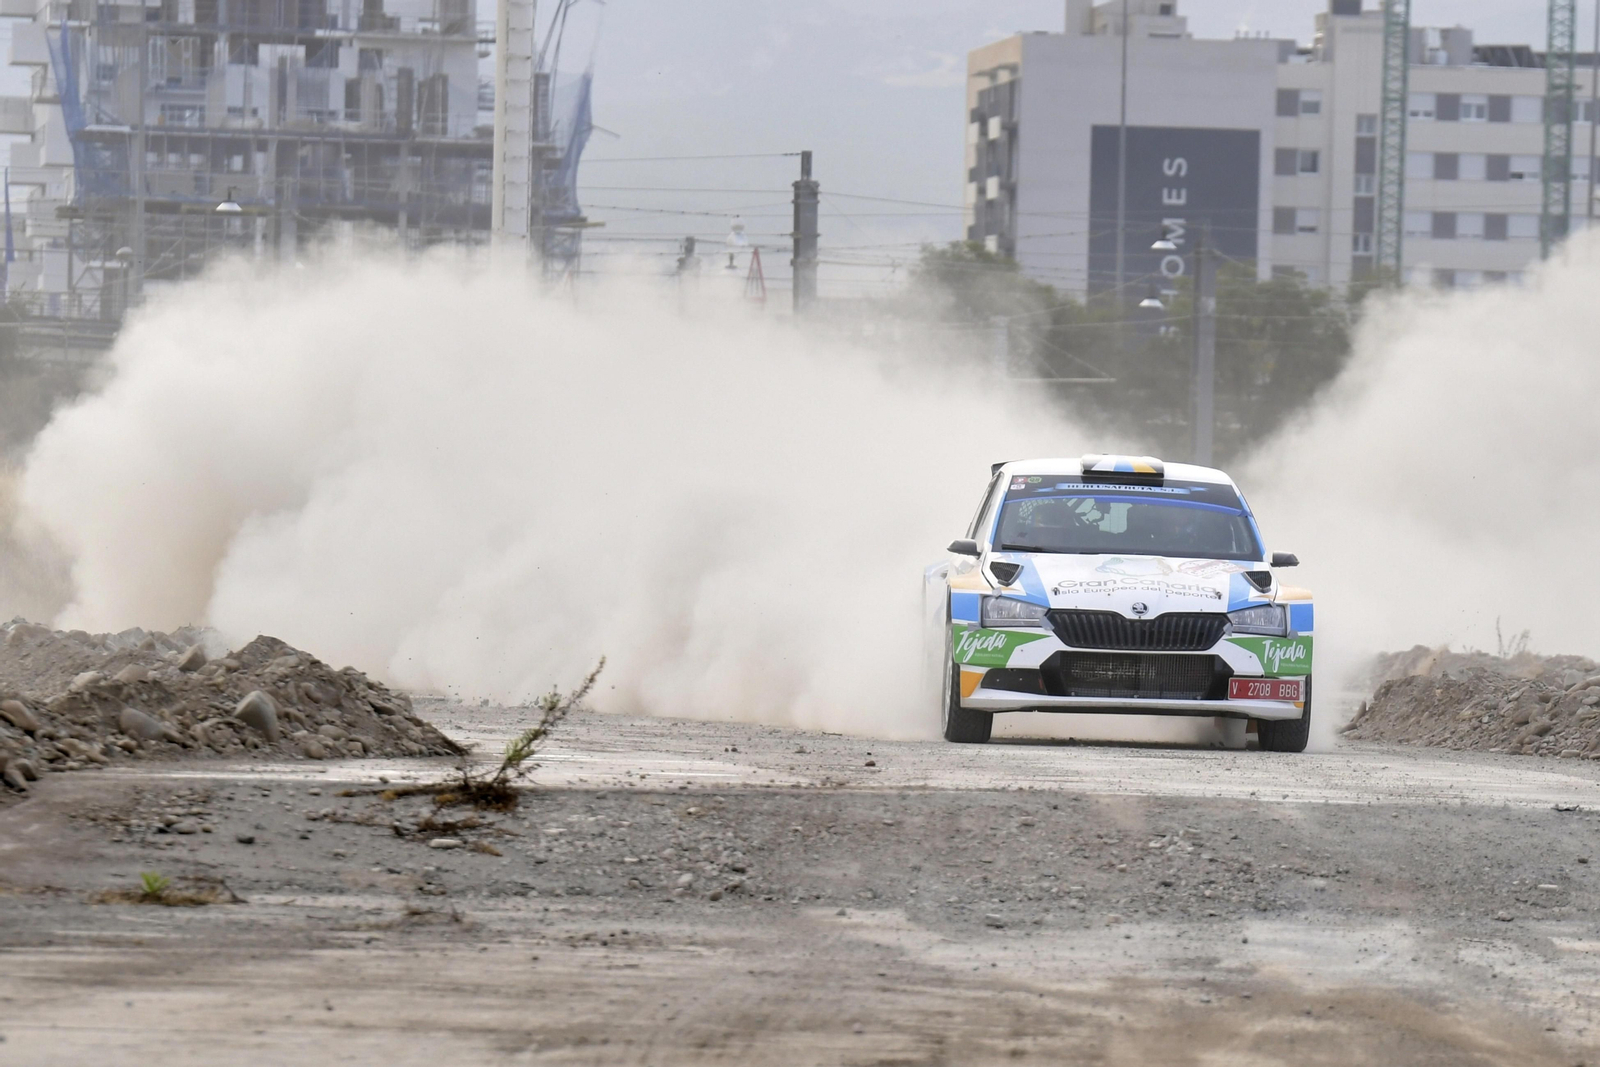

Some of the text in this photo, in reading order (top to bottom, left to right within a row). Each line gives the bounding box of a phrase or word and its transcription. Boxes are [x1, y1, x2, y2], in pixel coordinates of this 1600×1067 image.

[1057, 577, 1218, 593] Gran Canaria
[1084, 586, 1137, 594] Europea
[1165, 589, 1218, 600] Deporte
[956, 630, 1007, 663] Tejeda
[1262, 639, 1306, 673] Tejeda
[1232, 682, 1298, 698] V 2708 BBG
